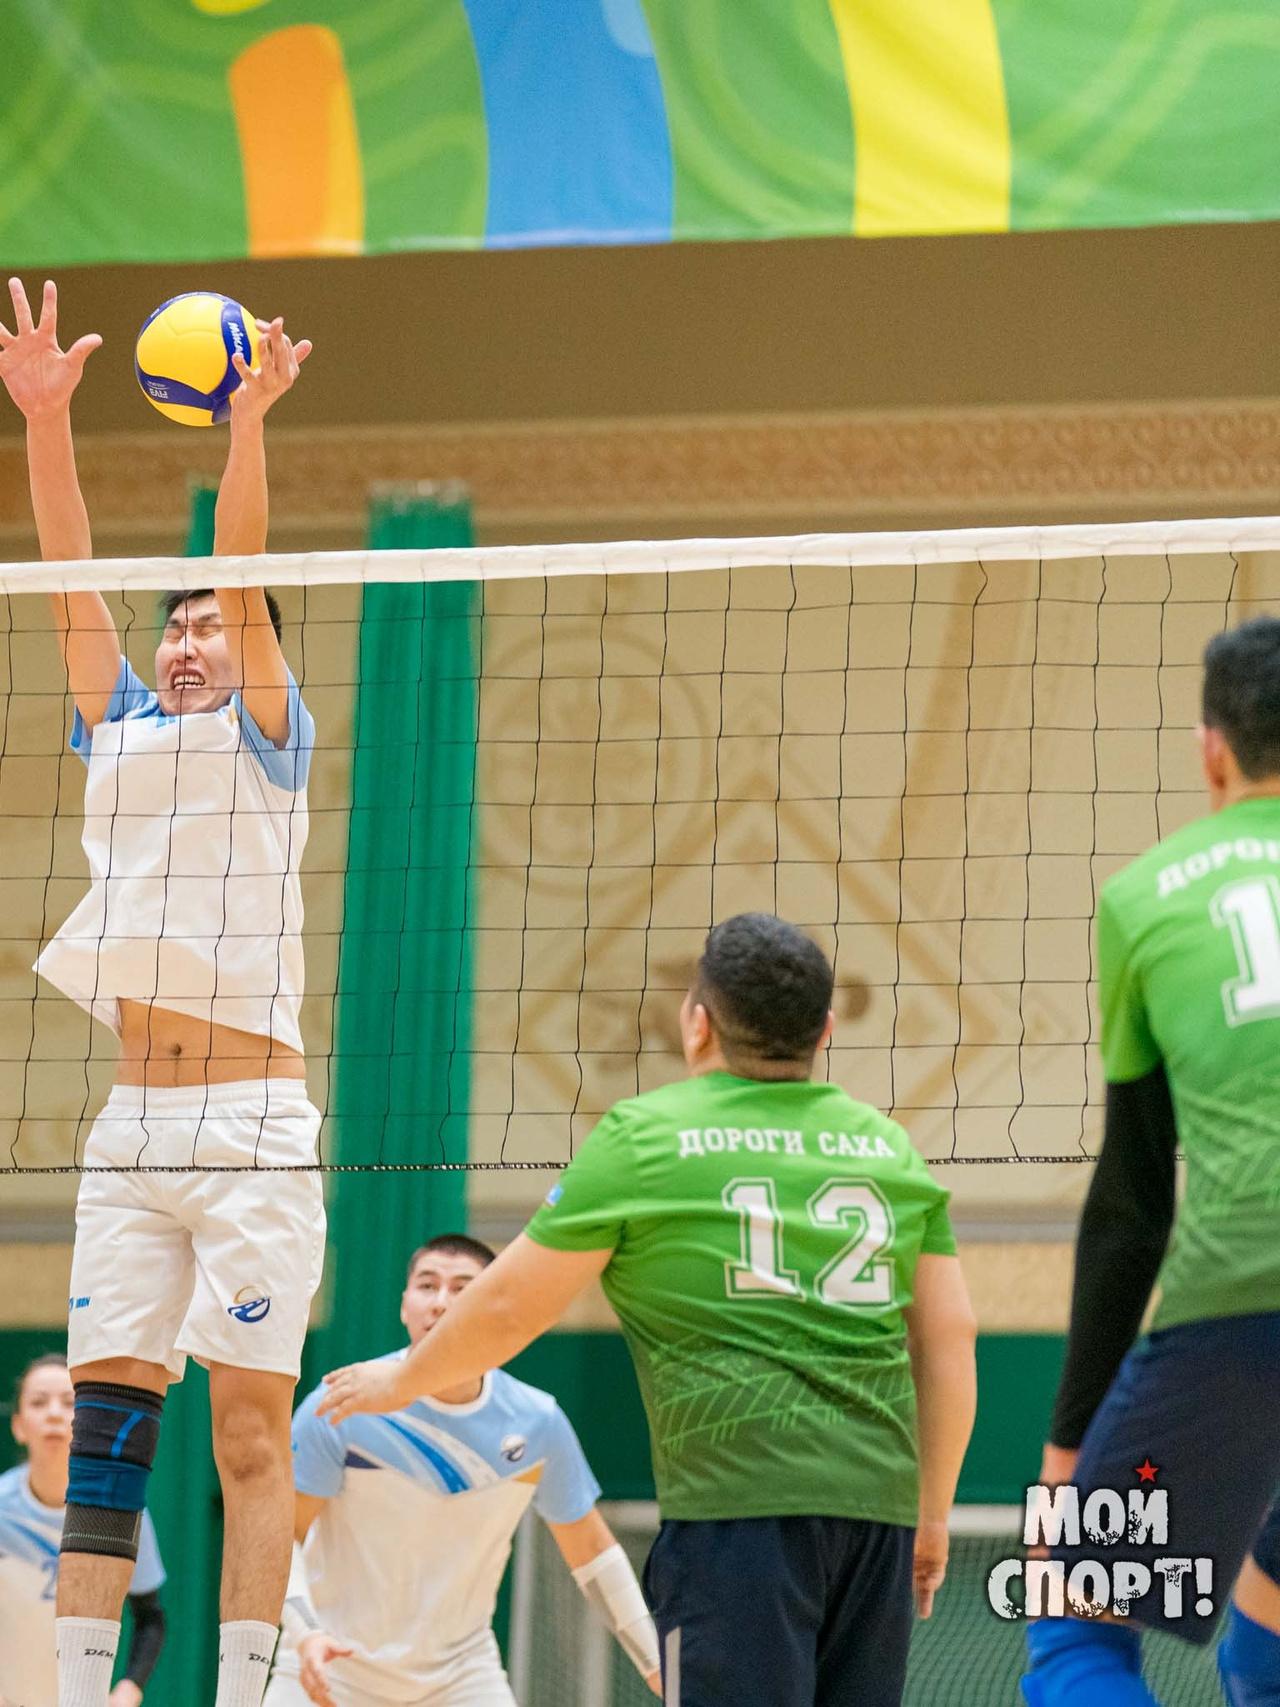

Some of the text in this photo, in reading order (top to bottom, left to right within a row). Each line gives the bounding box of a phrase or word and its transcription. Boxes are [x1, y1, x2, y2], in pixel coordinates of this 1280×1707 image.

[678, 1127, 896, 1159] ДОРОГИ САХА
[721, 1177, 897, 1311] 12
